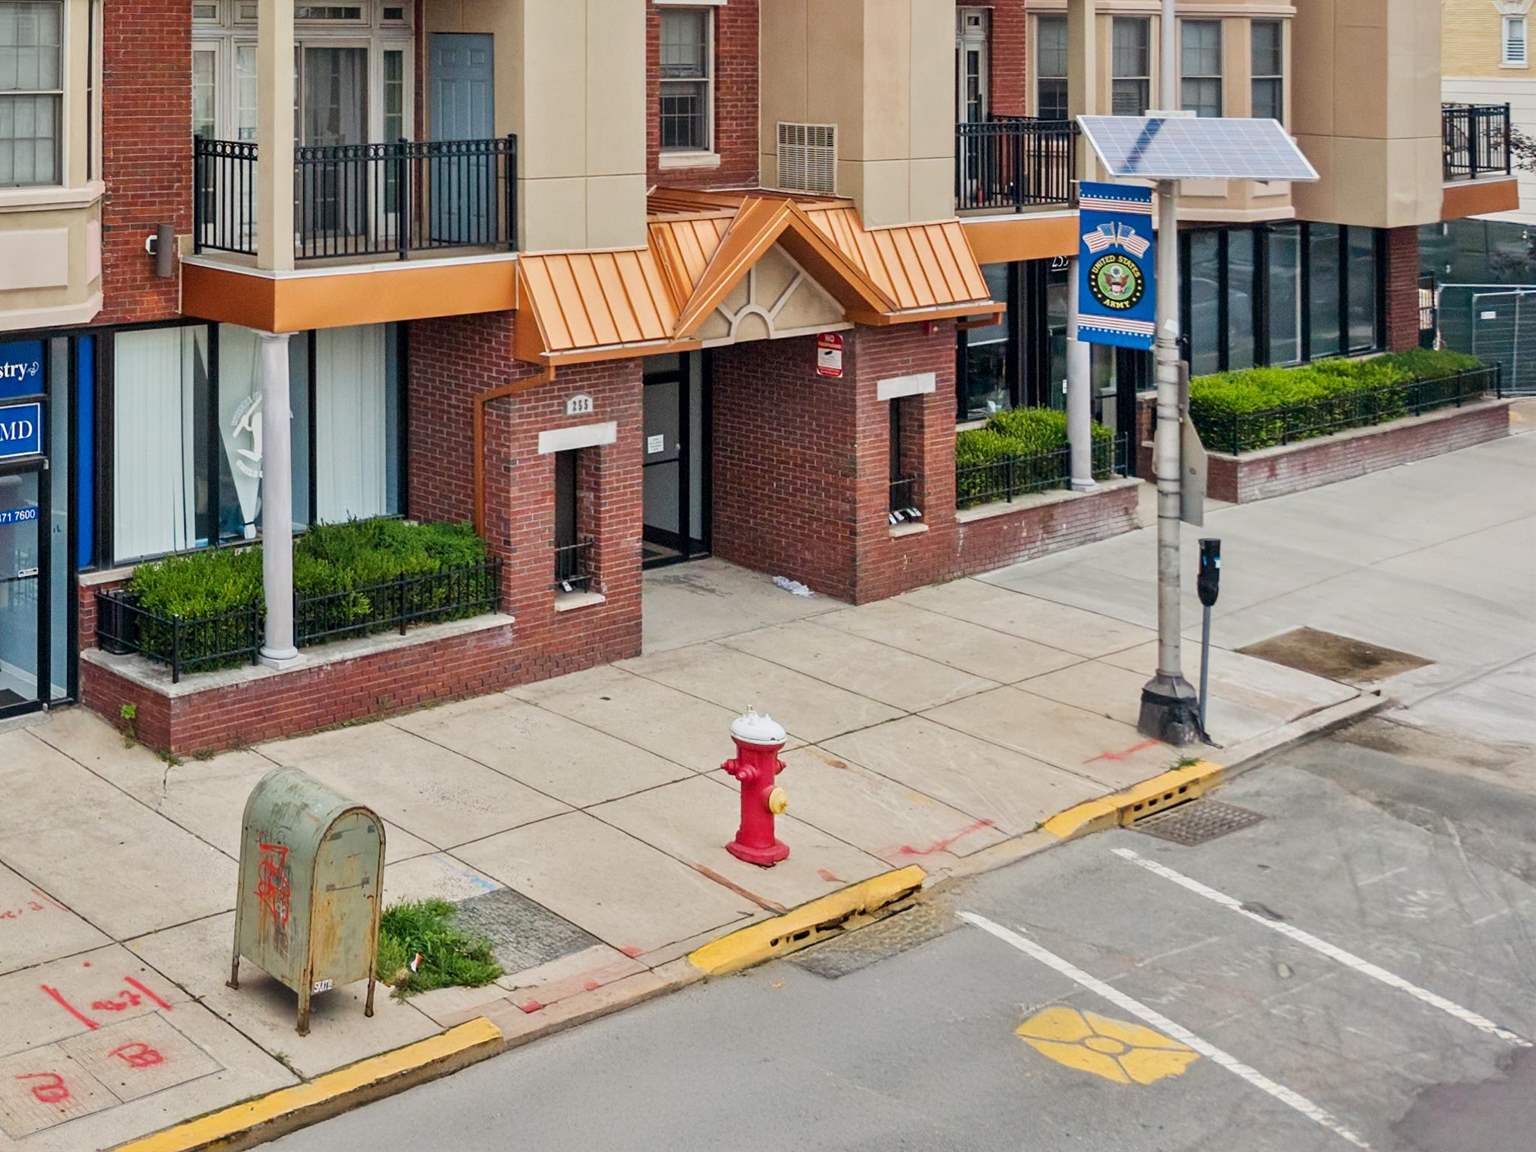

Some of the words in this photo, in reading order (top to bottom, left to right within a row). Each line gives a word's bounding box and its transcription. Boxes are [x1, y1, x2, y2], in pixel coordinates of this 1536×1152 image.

[1091, 254, 1116, 274] UNITED
[1118, 255, 1141, 278] STATES
[1103, 298, 1130, 309] ARMY
[572, 398, 589, 412] 255
[14, 509, 36, 521] 7600
